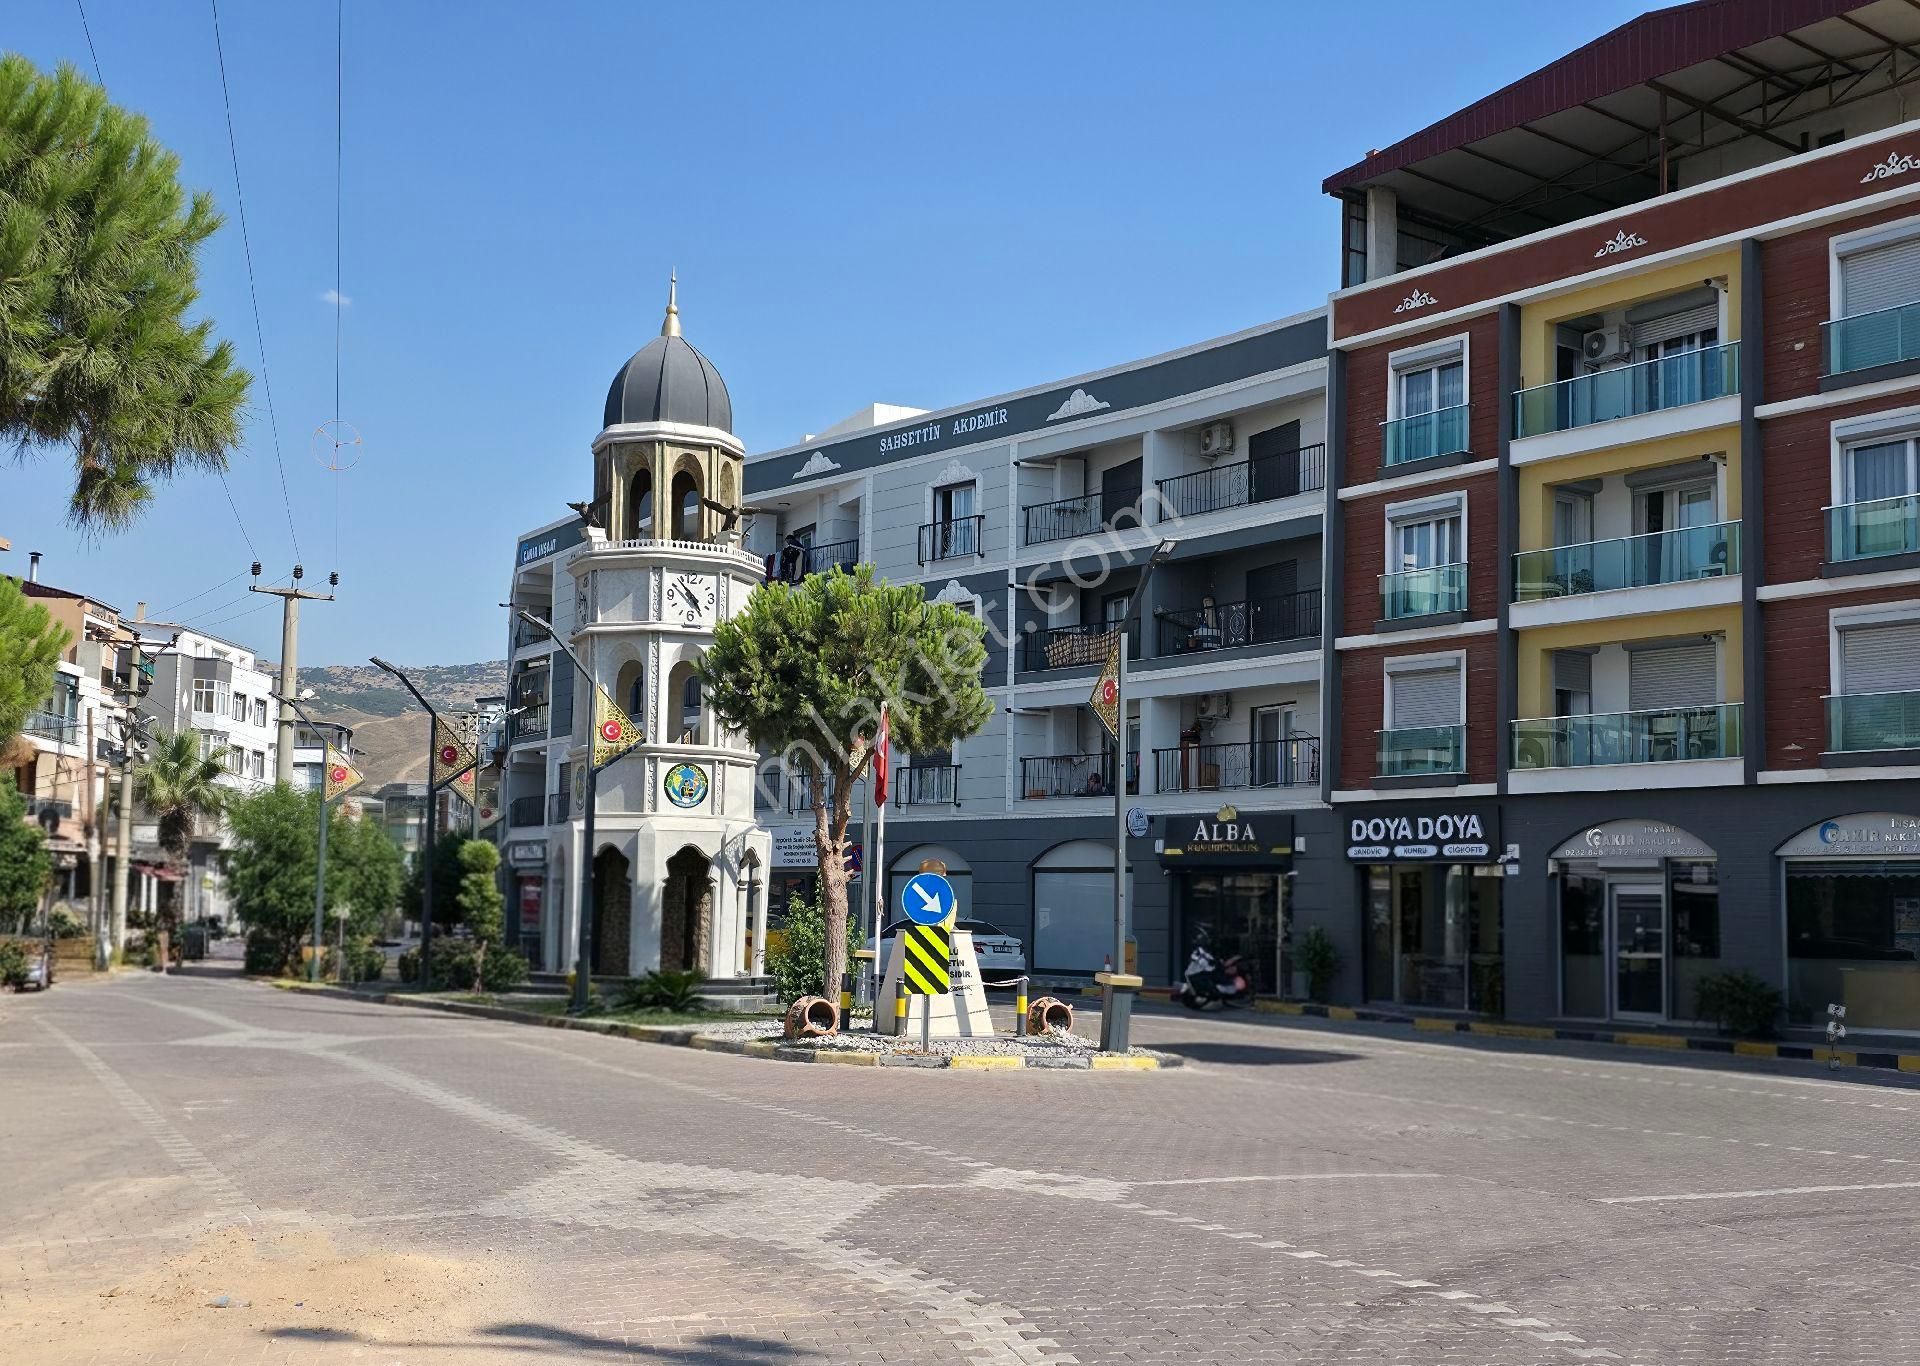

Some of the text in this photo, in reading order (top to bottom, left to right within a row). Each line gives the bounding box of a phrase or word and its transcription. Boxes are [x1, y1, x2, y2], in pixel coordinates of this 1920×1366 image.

[953, 407, 1008, 435] AKDEMİR
[685, 572, 697, 584] 12
[667, 589, 674, 600] 9
[708, 593, 714, 604] 3
[687, 610, 694, 621] 6
[1193, 820, 1255, 840] ALBA
[1352, 815, 1482, 841] DOYA DOYA
[949, 947, 958, 955] LÜ
[950, 970, 973, 978] SİDİR.
